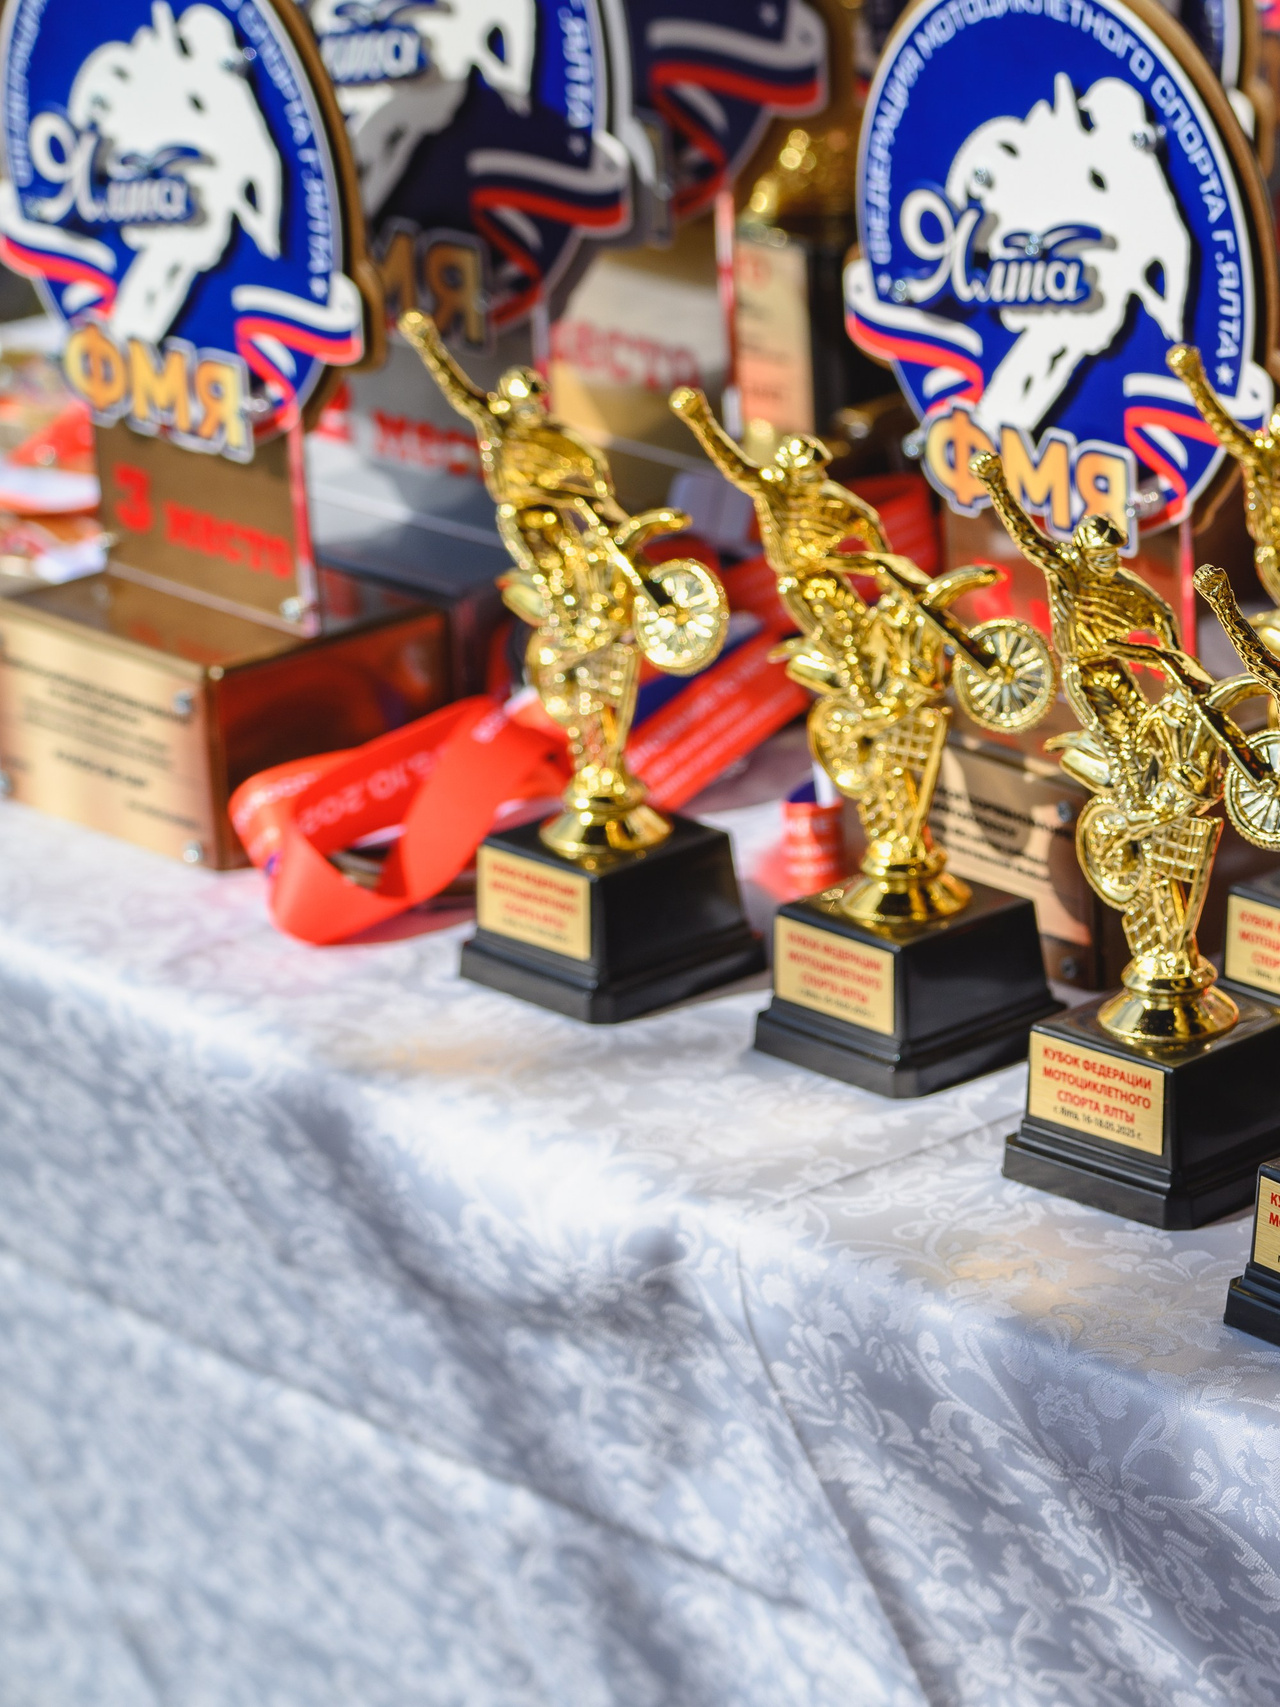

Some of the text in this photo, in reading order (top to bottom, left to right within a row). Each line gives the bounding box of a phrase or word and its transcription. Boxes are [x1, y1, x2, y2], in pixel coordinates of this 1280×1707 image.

[1150, 74, 1227, 225] СПОРТА
[900, 188, 1092, 303] Ялта
[65, 324, 245, 449] ФМЯ
[925, 410, 1130, 545] ФМЯ
[1043, 1046, 1153, 1092] КУБОК ФЕДЕРАЦИИ
[1043, 1065, 1152, 1110] МОТОЦИКЛЕТНОГО
[1057, 1089, 1136, 1125] СПОРТА ЯЛТЫ
